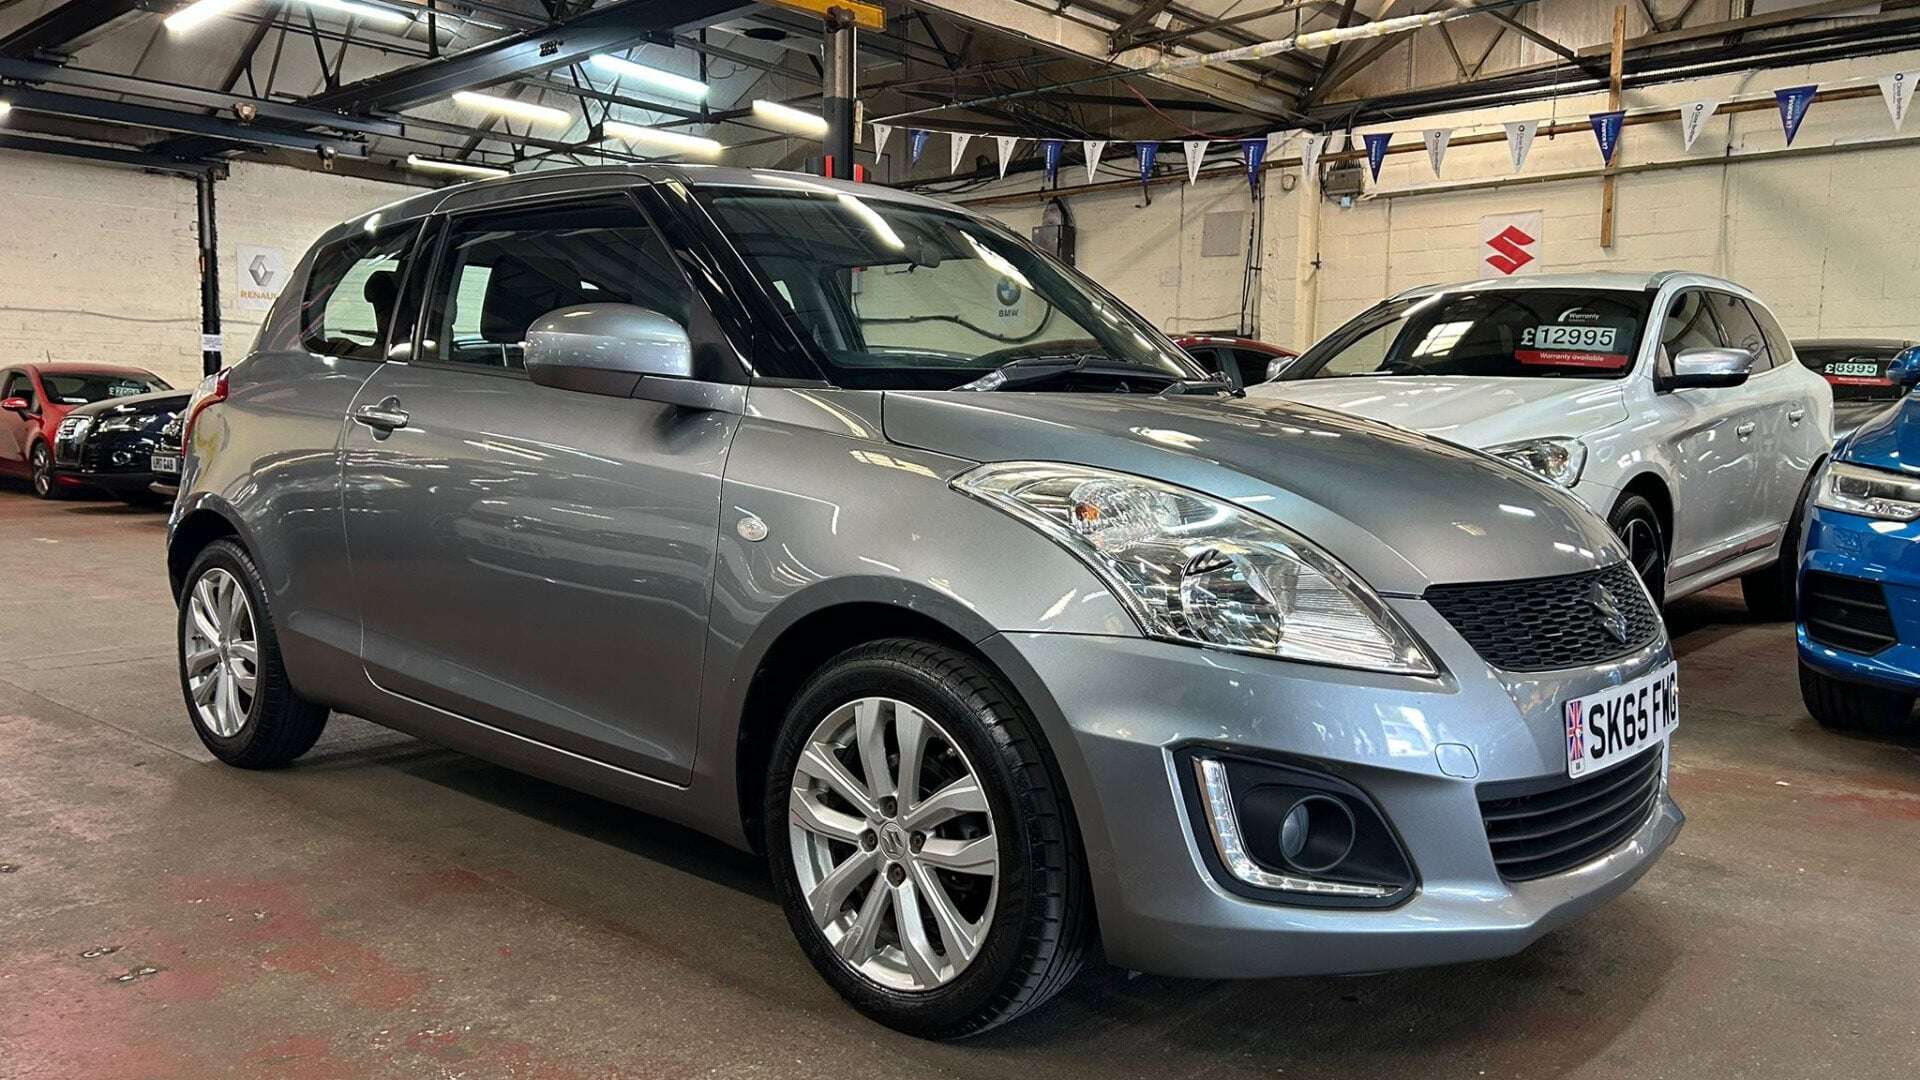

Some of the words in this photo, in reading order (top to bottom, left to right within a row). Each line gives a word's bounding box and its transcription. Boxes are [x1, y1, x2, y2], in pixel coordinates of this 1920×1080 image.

[240, 290, 278, 300] RENAU
[999, 309, 1019, 317] BMW
[1569, 313, 1600, 321] Warranty
[1521, 327, 1613, 346] £12995
[1540, 351, 1571, 361] Warranty
[1588, 687, 1648, 760] SK65
